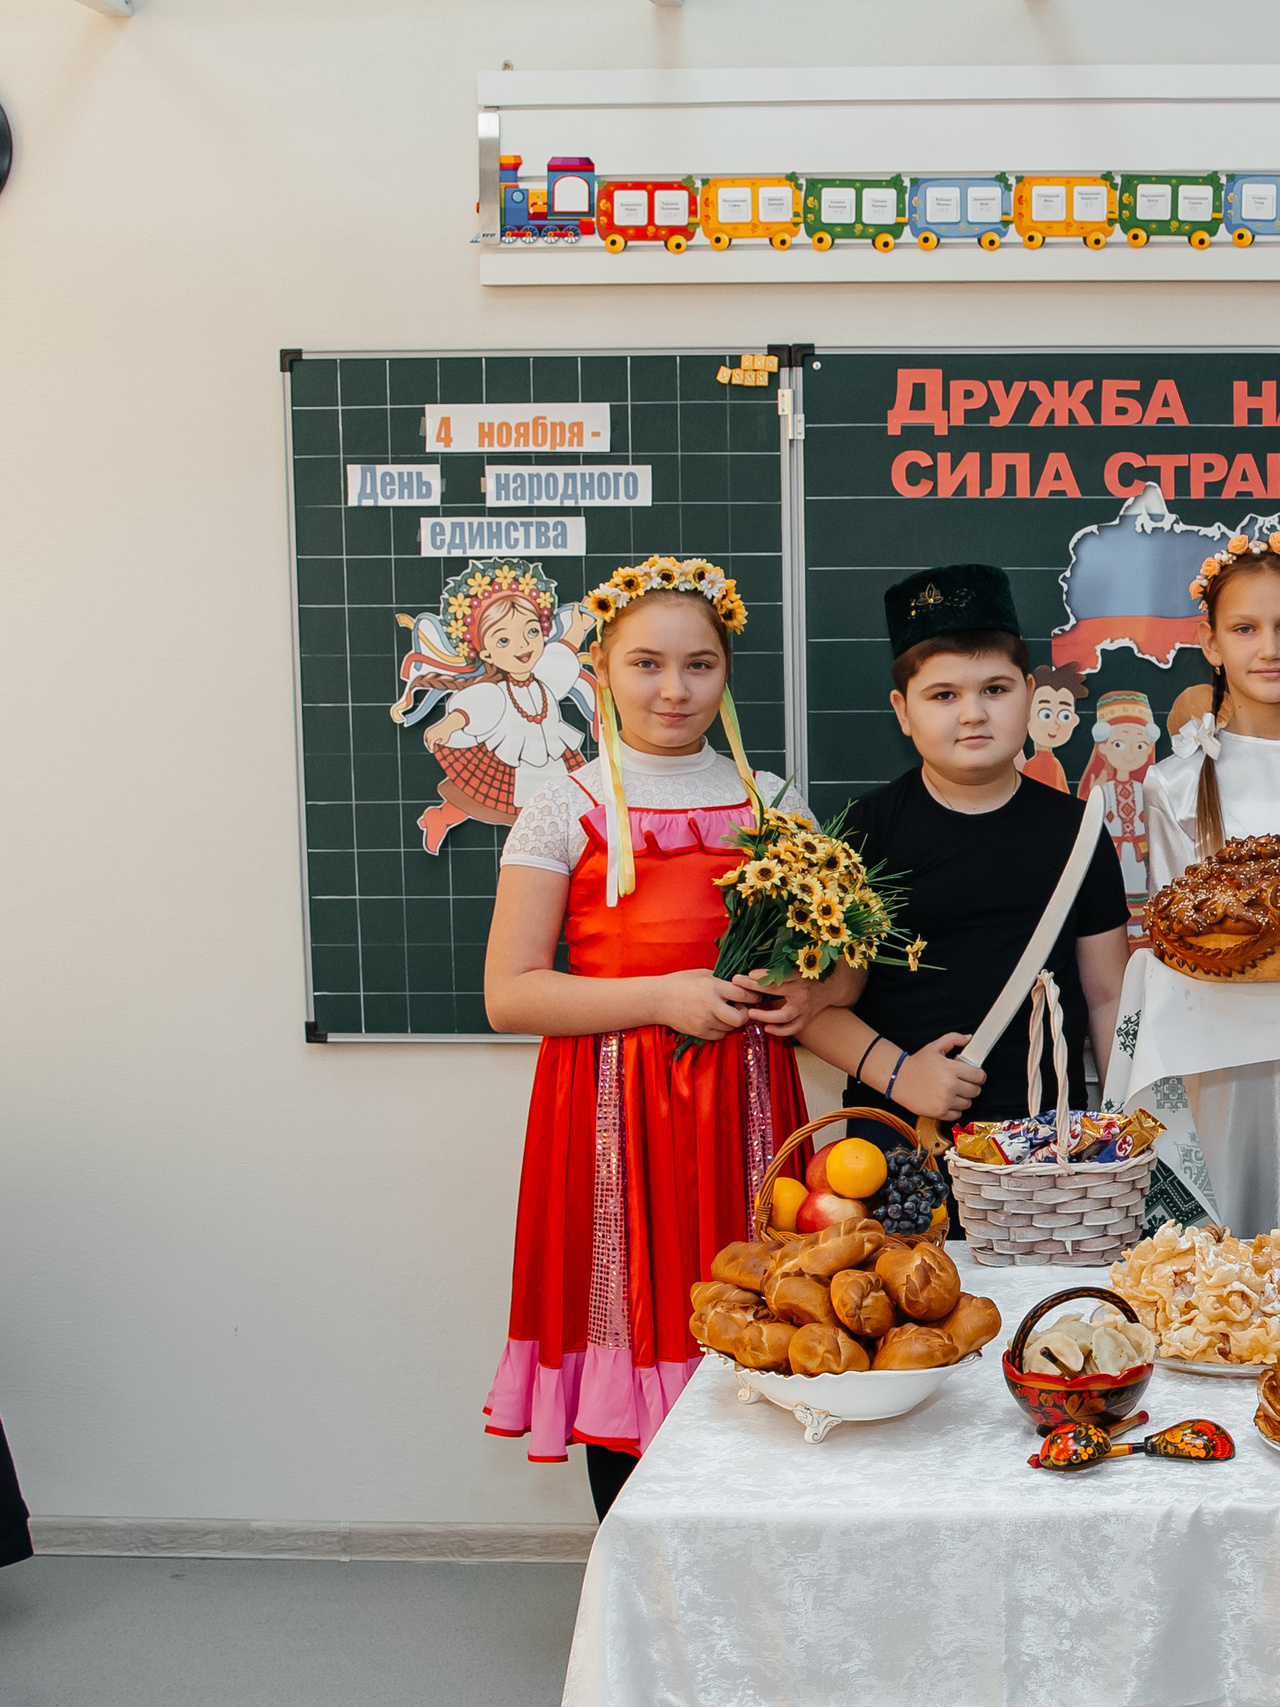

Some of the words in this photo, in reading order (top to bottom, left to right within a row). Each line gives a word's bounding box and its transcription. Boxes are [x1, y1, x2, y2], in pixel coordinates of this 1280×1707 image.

[435, 416, 453, 448] 4
[357, 465, 433, 506] День
[494, 471, 639, 505] народного
[891, 451, 1082, 499] СИЛА
[429, 520, 568, 555] единства
